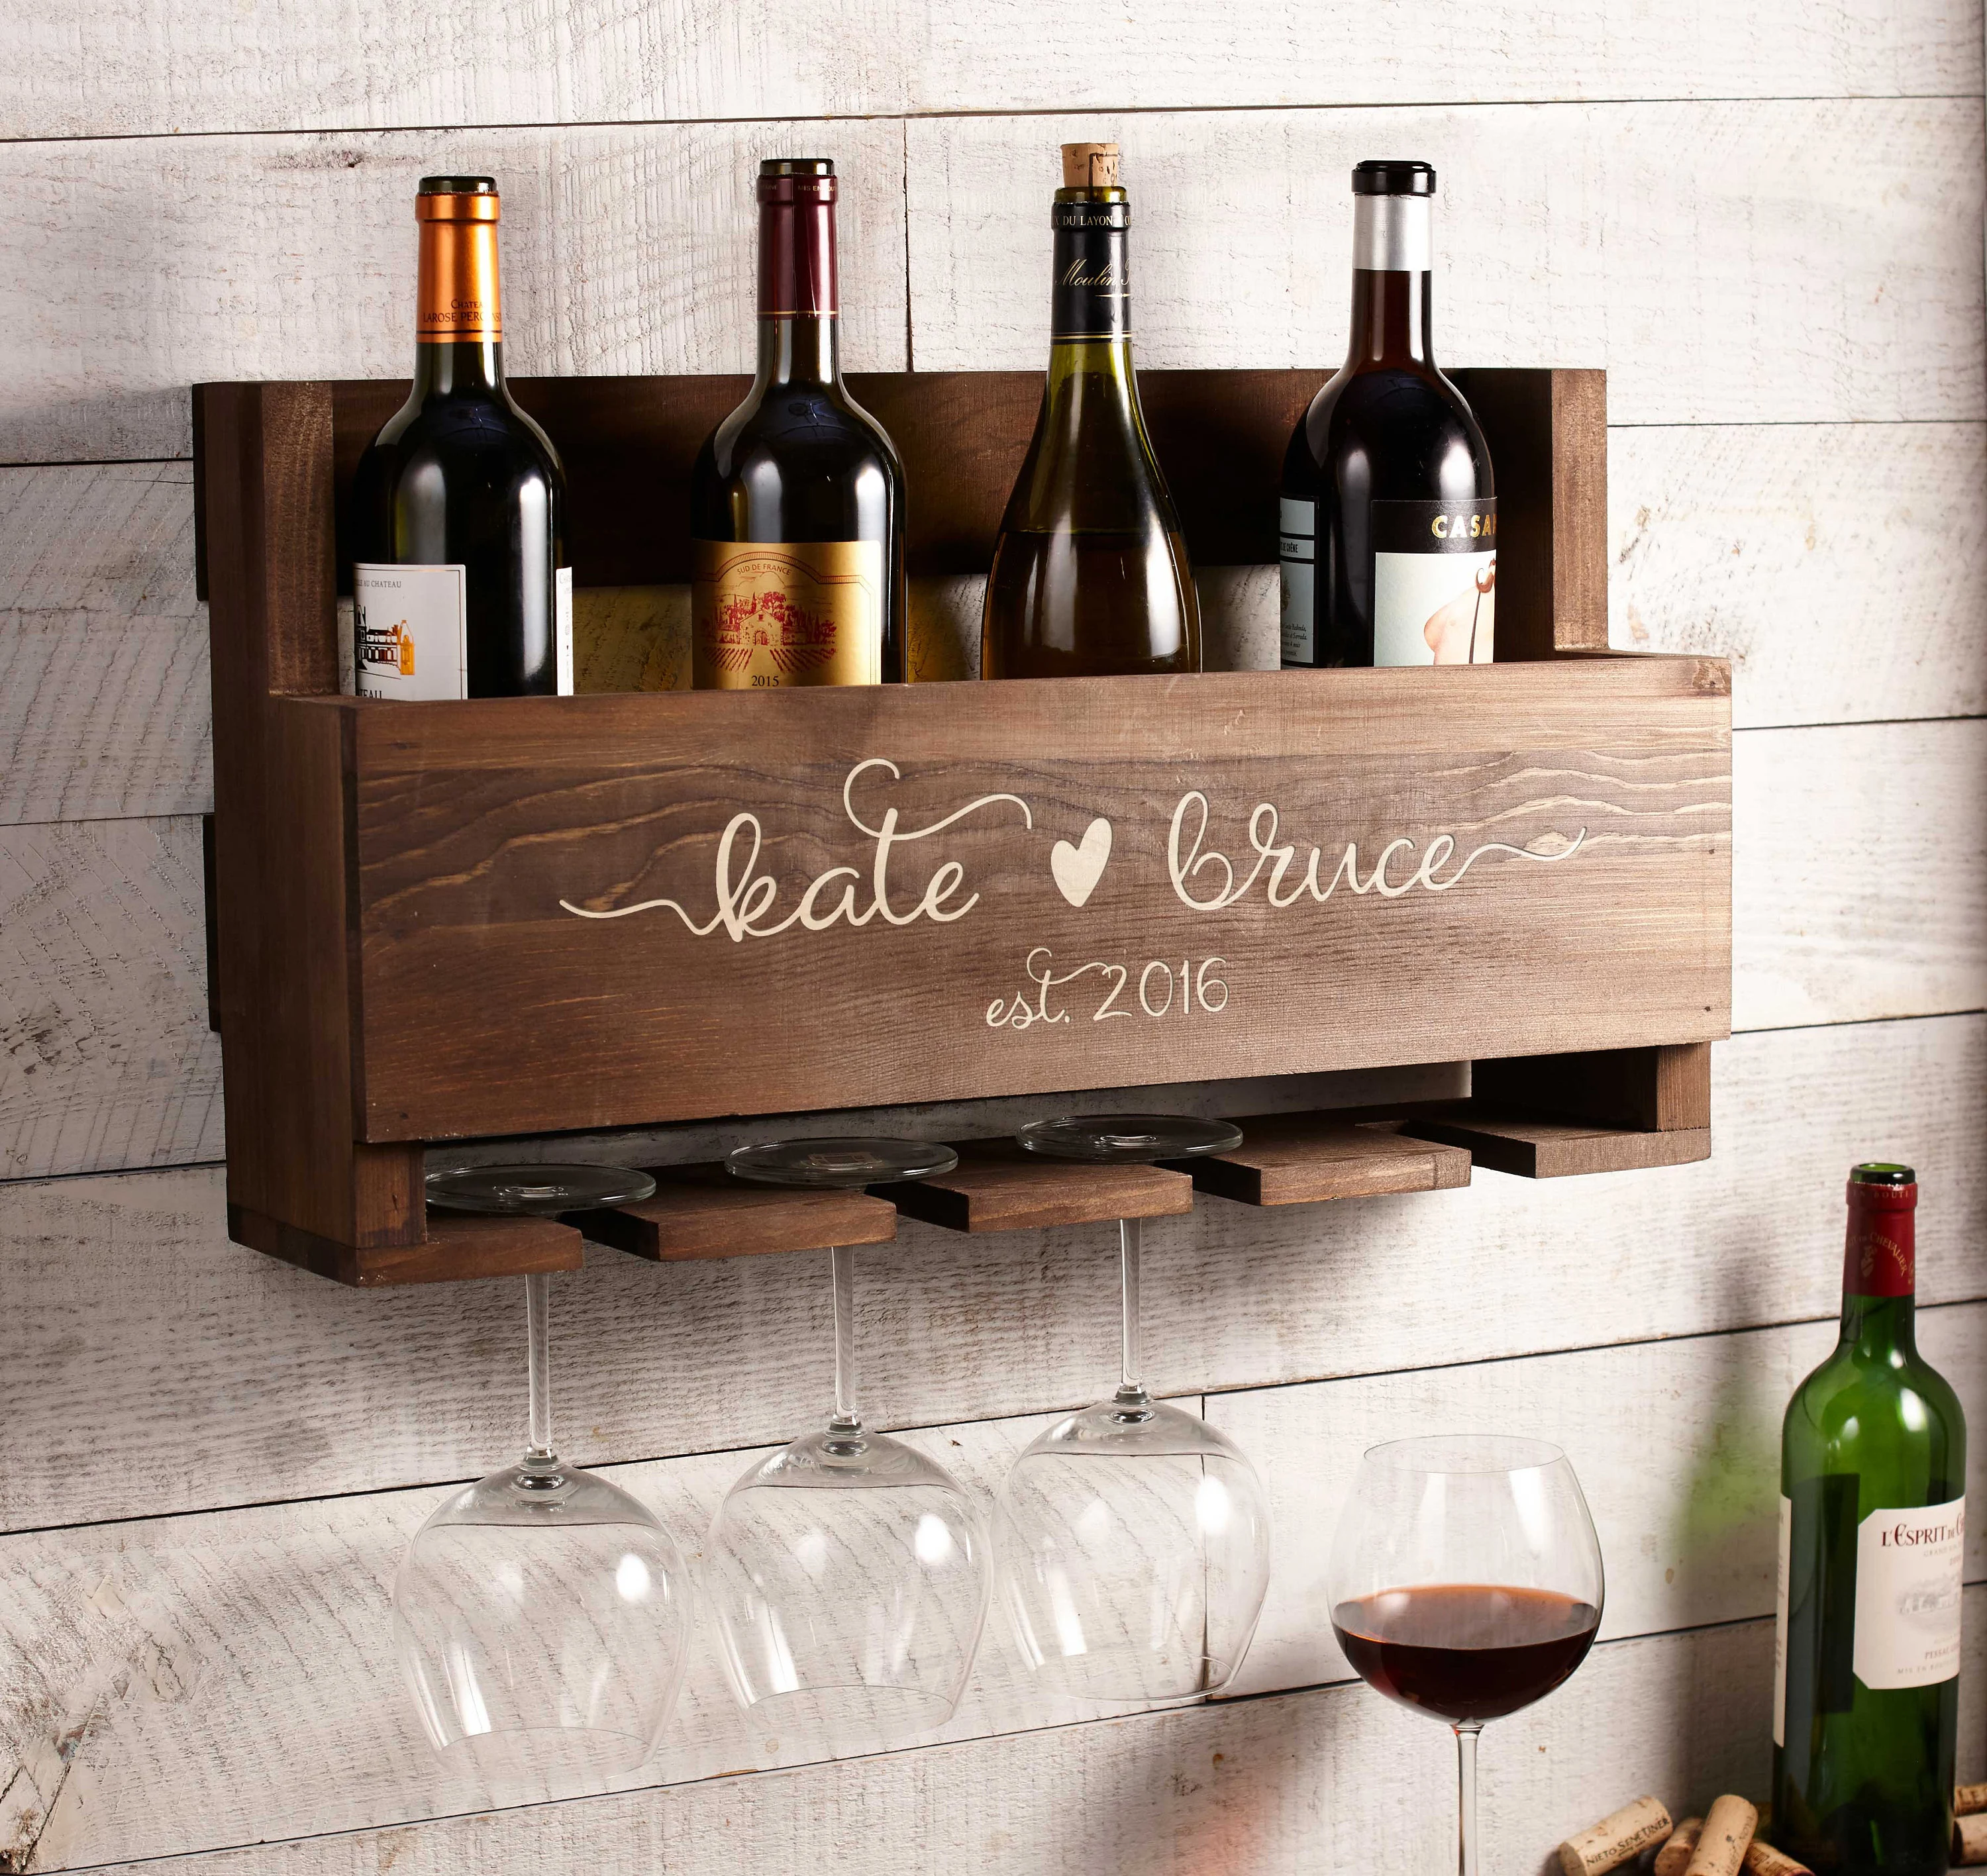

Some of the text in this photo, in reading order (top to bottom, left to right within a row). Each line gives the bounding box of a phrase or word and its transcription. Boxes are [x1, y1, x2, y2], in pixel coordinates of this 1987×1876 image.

[1063, 216, 1076, 226] DU
[1080, 216, 1113, 226] LAYON
[1055, 258, 1117, 287] Moulin
[423, 312, 458, 323] LAROSE
[1286, 542, 1298, 553] CHÊNE
[737, 564, 751, 575] SUD
[763, 563, 792, 576] FRANCE
[371, 580, 402, 589] CHATEAU
[751, 674, 780, 687] 2015
[559, 758, 1587, 943] kate bruce
[986, 947, 1230, 1030] est. 2016
[1870, 1232, 1908, 1277] CHEVALIER
[1586, 1847, 1617, 1867] NIETO
